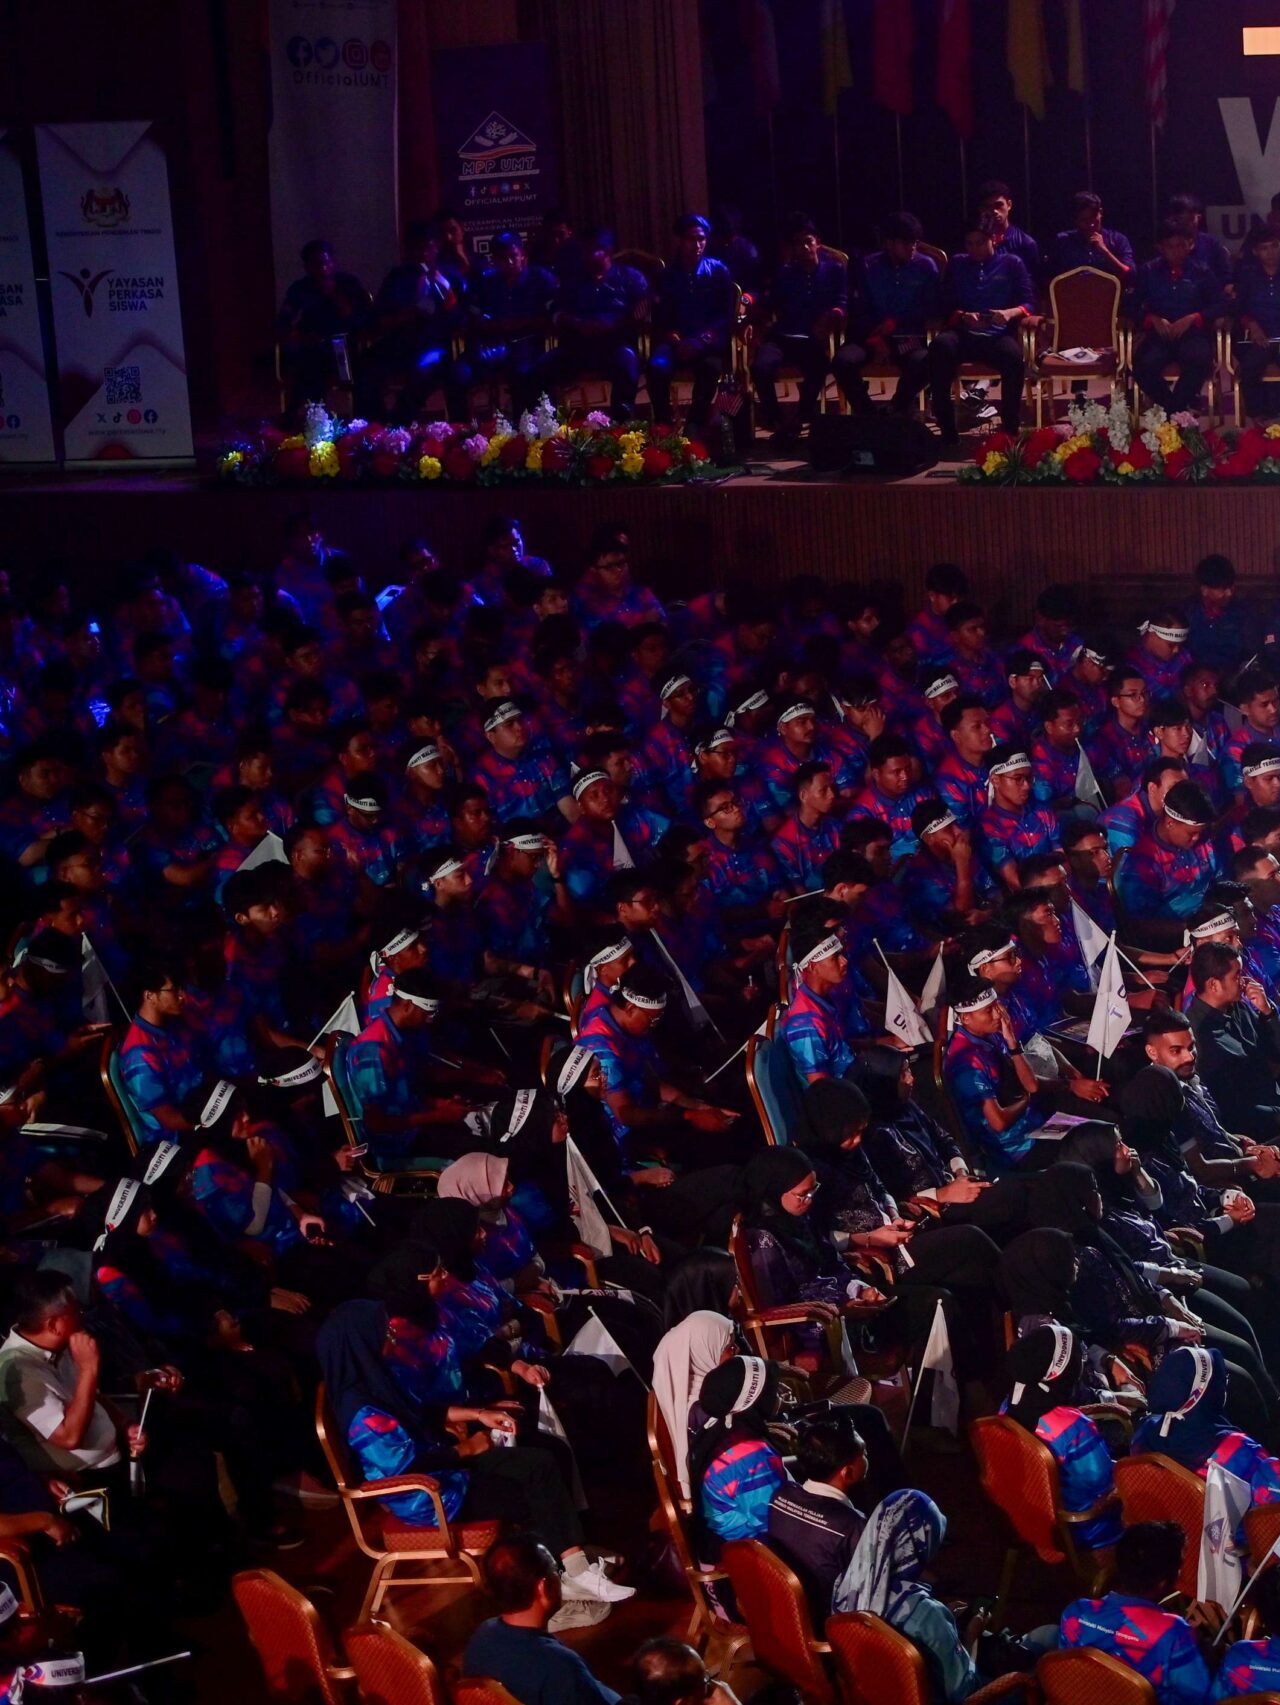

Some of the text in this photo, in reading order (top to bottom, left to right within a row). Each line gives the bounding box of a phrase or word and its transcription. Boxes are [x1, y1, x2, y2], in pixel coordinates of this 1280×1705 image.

[462, 156, 536, 175] MPP UMT
[107, 276, 164, 289] YAYASAN
[108, 289, 164, 300] PERKASA
[109, 301, 148, 312] SISWA
